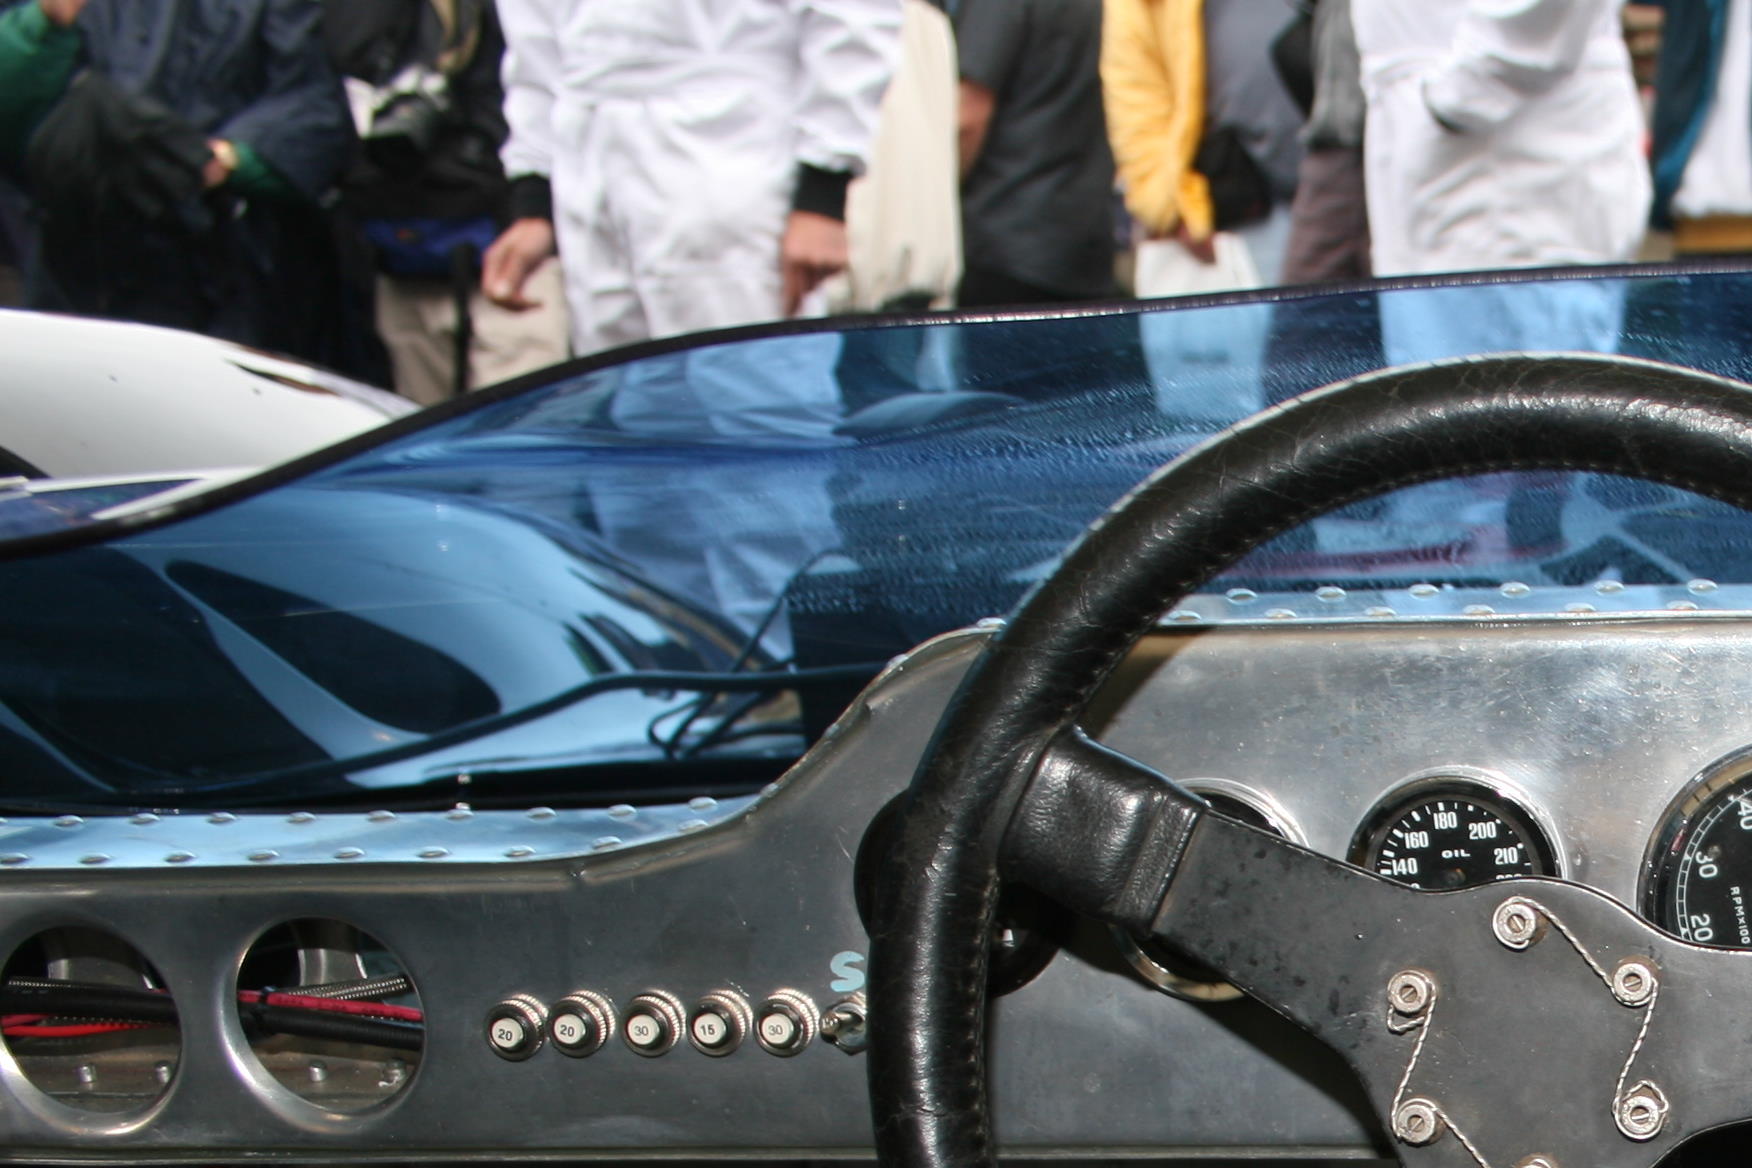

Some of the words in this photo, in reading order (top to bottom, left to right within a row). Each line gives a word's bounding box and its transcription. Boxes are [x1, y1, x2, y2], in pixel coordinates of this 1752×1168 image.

[1433, 812, 1457, 829] 180
[1468, 822, 1496, 840] 200
[1405, 831, 1429, 849] 160
[1494, 847, 1518, 865] 210
[1392, 858, 1417, 874] 140
[1695, 852, 1717, 879] 30
[1691, 914, 1713, 942] 20
[830, 951, 865, 992] S
[497, 1029, 513, 1042] 20
[560, 1024, 575, 1037] 20
[634, 1024, 649, 1037] 30
[700, 1024, 716, 1036] 15
[768, 1024, 784, 1036] 30
